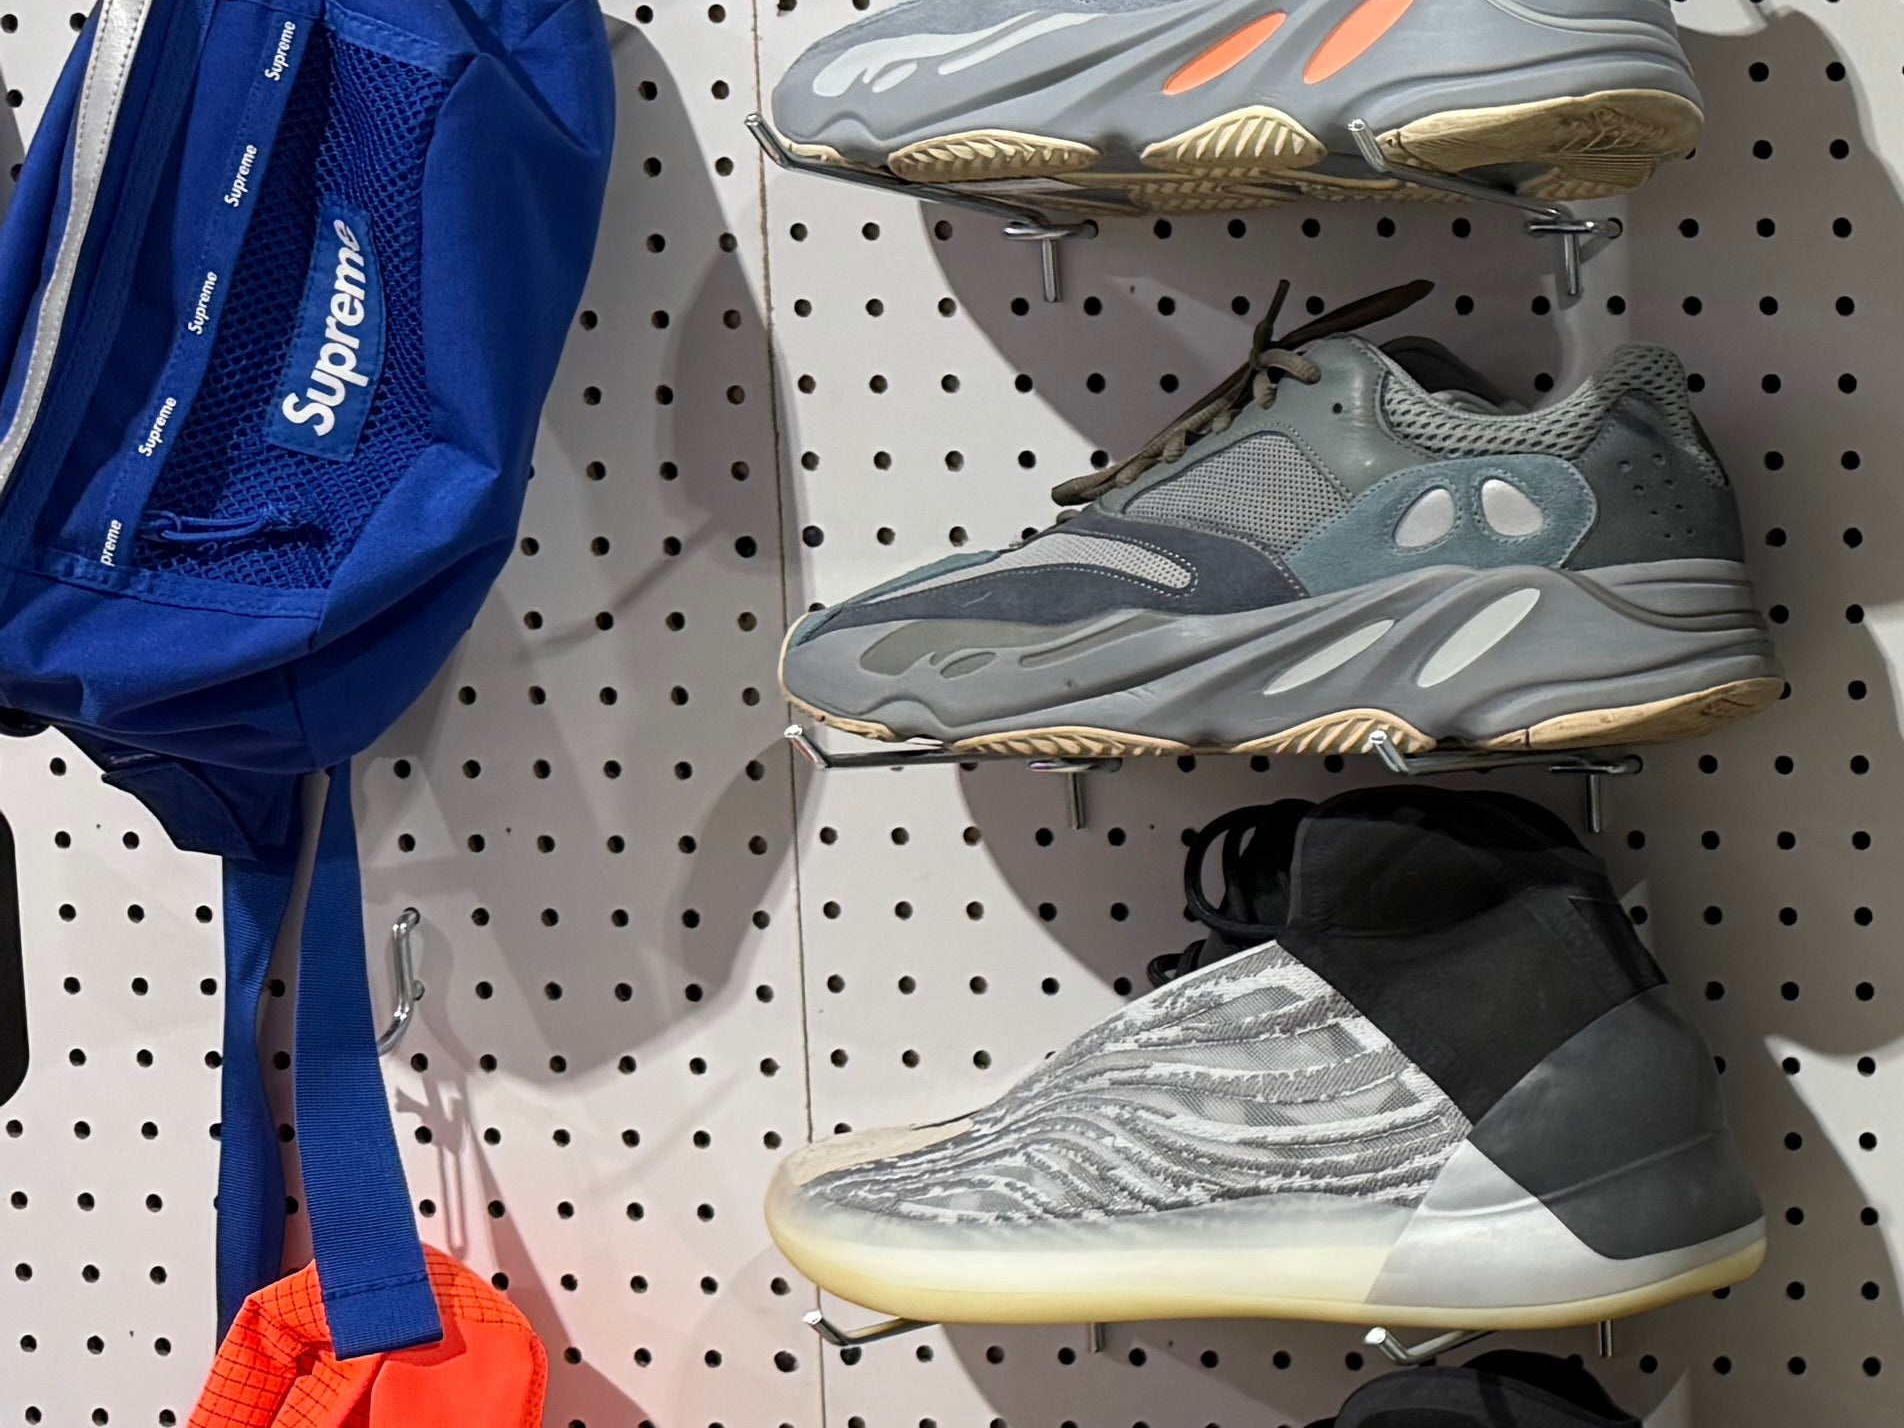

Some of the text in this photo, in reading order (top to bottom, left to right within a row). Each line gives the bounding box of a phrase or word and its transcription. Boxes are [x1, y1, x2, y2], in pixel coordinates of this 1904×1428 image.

[265, 19, 296, 82] Supreme
[223, 144, 257, 208] Supreme
[188, 271, 218, 335] Supreme
[282, 218, 366, 438] Supreme
[138, 396, 177, 458] Supreme
